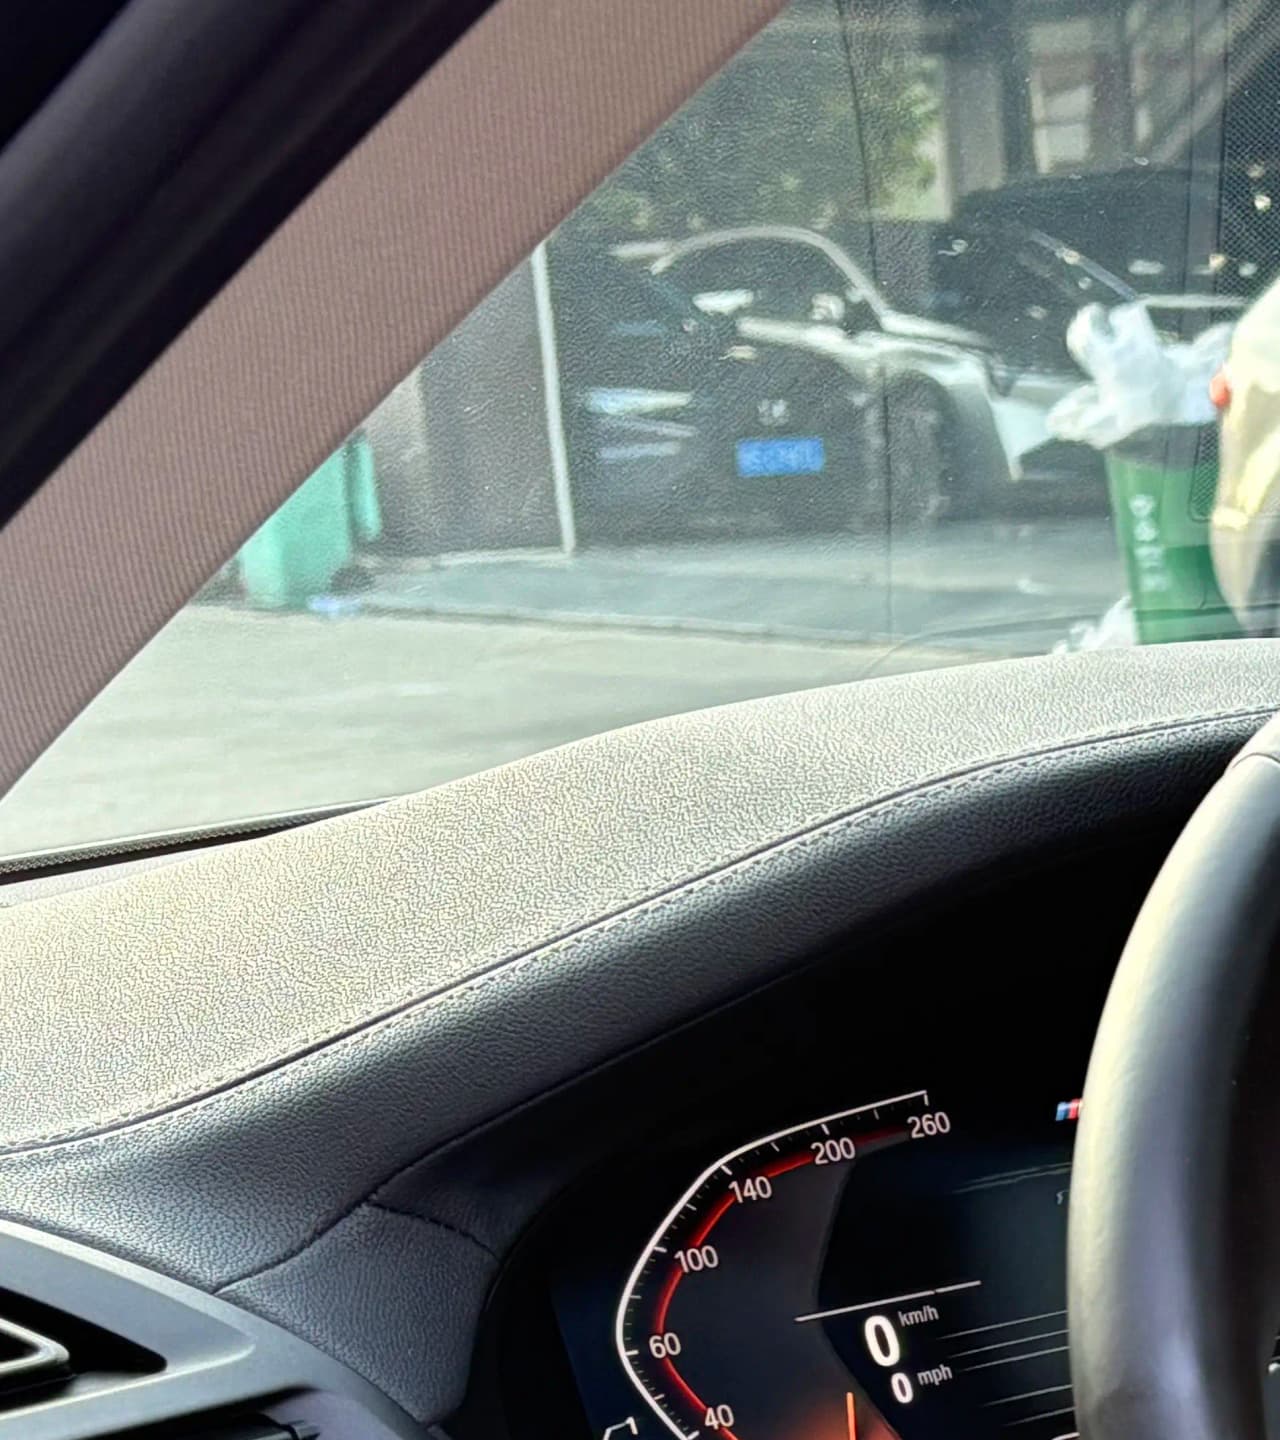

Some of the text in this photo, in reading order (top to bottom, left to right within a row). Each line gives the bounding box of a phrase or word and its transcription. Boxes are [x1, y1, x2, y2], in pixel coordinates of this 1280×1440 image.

[907, 1110, 951, 1139] 260
[810, 1136, 856, 1165] 200
[729, 1175, 773, 1204] 140
[674, 1245, 719, 1274] 100
[649, 1331, 681, 1359] 60
[864, 1305, 939, 1367] 0 km/h
[891, 1363, 953, 1405] 0 mph
[627, 1416, 639, 1435] 1
[704, 1404, 734, 1429] 40
